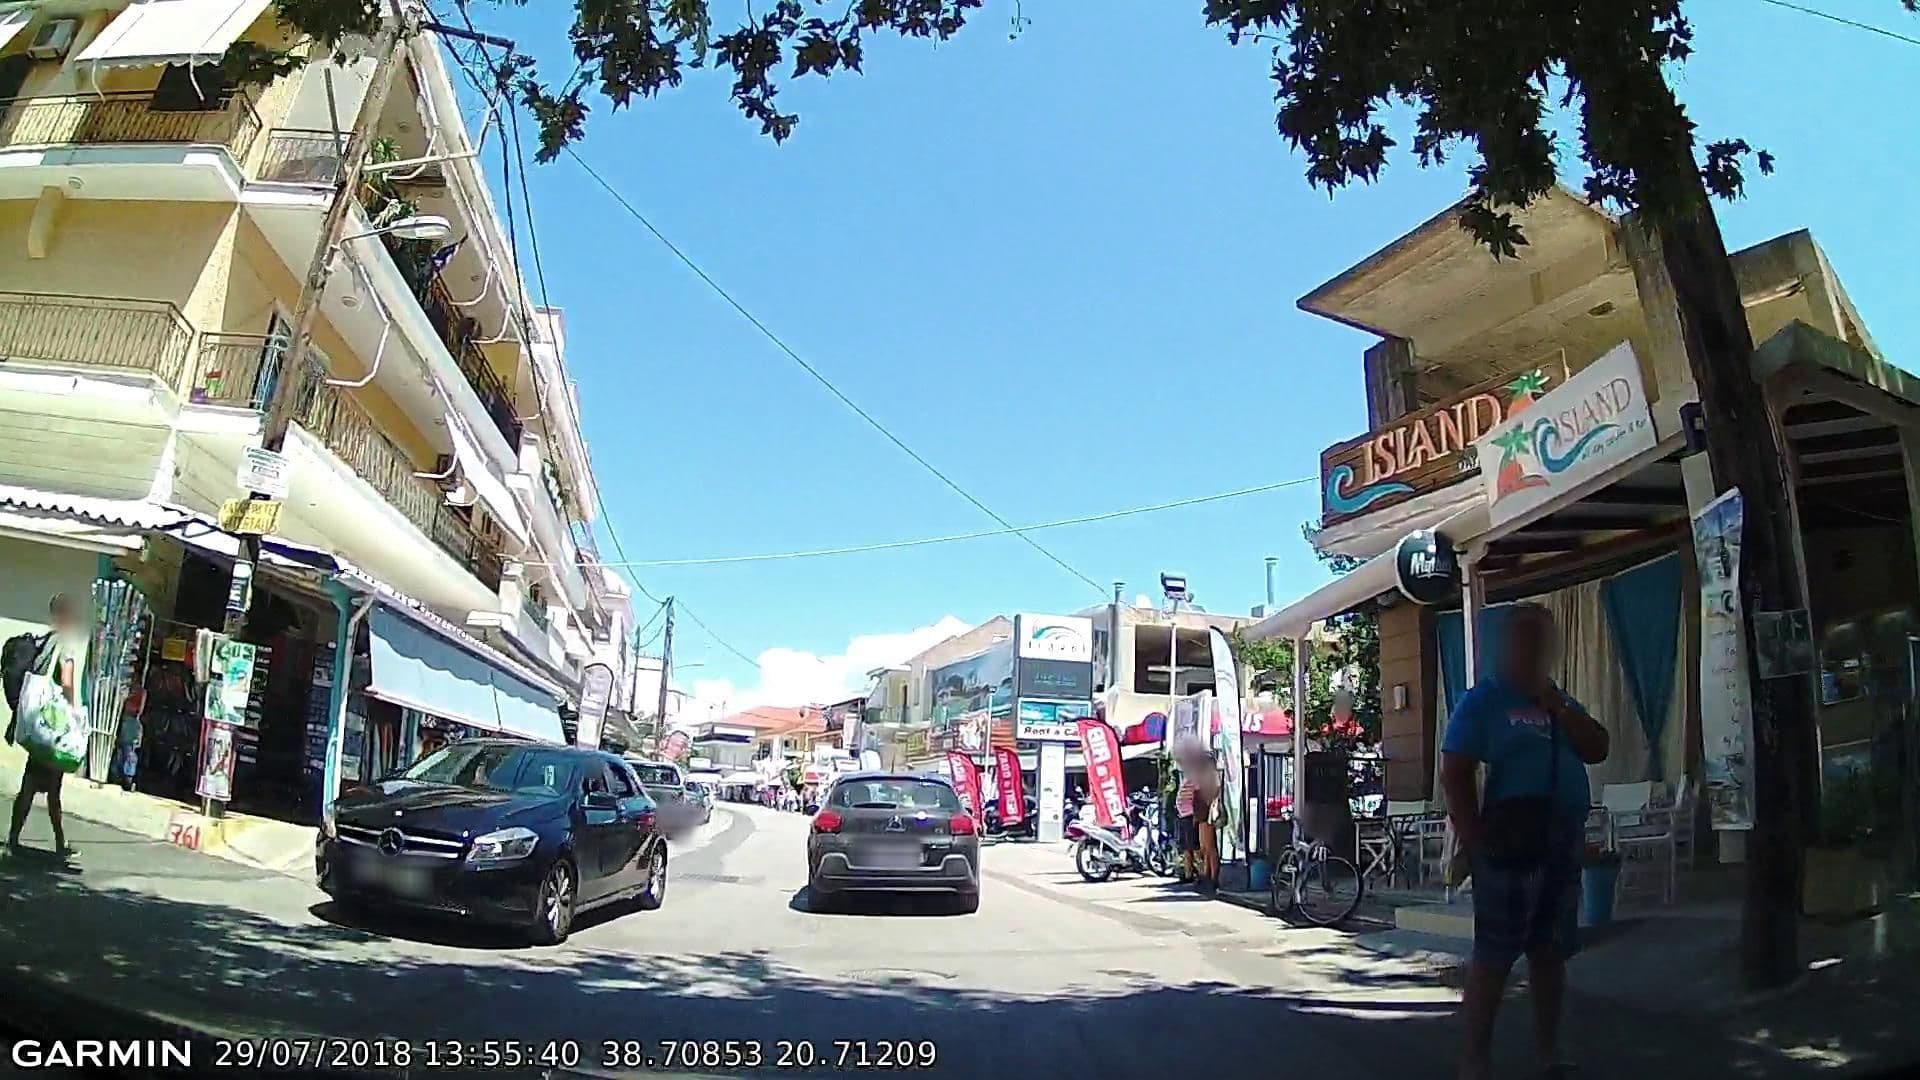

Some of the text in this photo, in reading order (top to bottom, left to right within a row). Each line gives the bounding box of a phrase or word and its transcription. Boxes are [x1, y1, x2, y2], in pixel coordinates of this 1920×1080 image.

[1363, 394, 1502, 486] ISLAND
[1552, 377, 1631, 447] ISLAND
[1064, 728, 1079, 737] Ca
